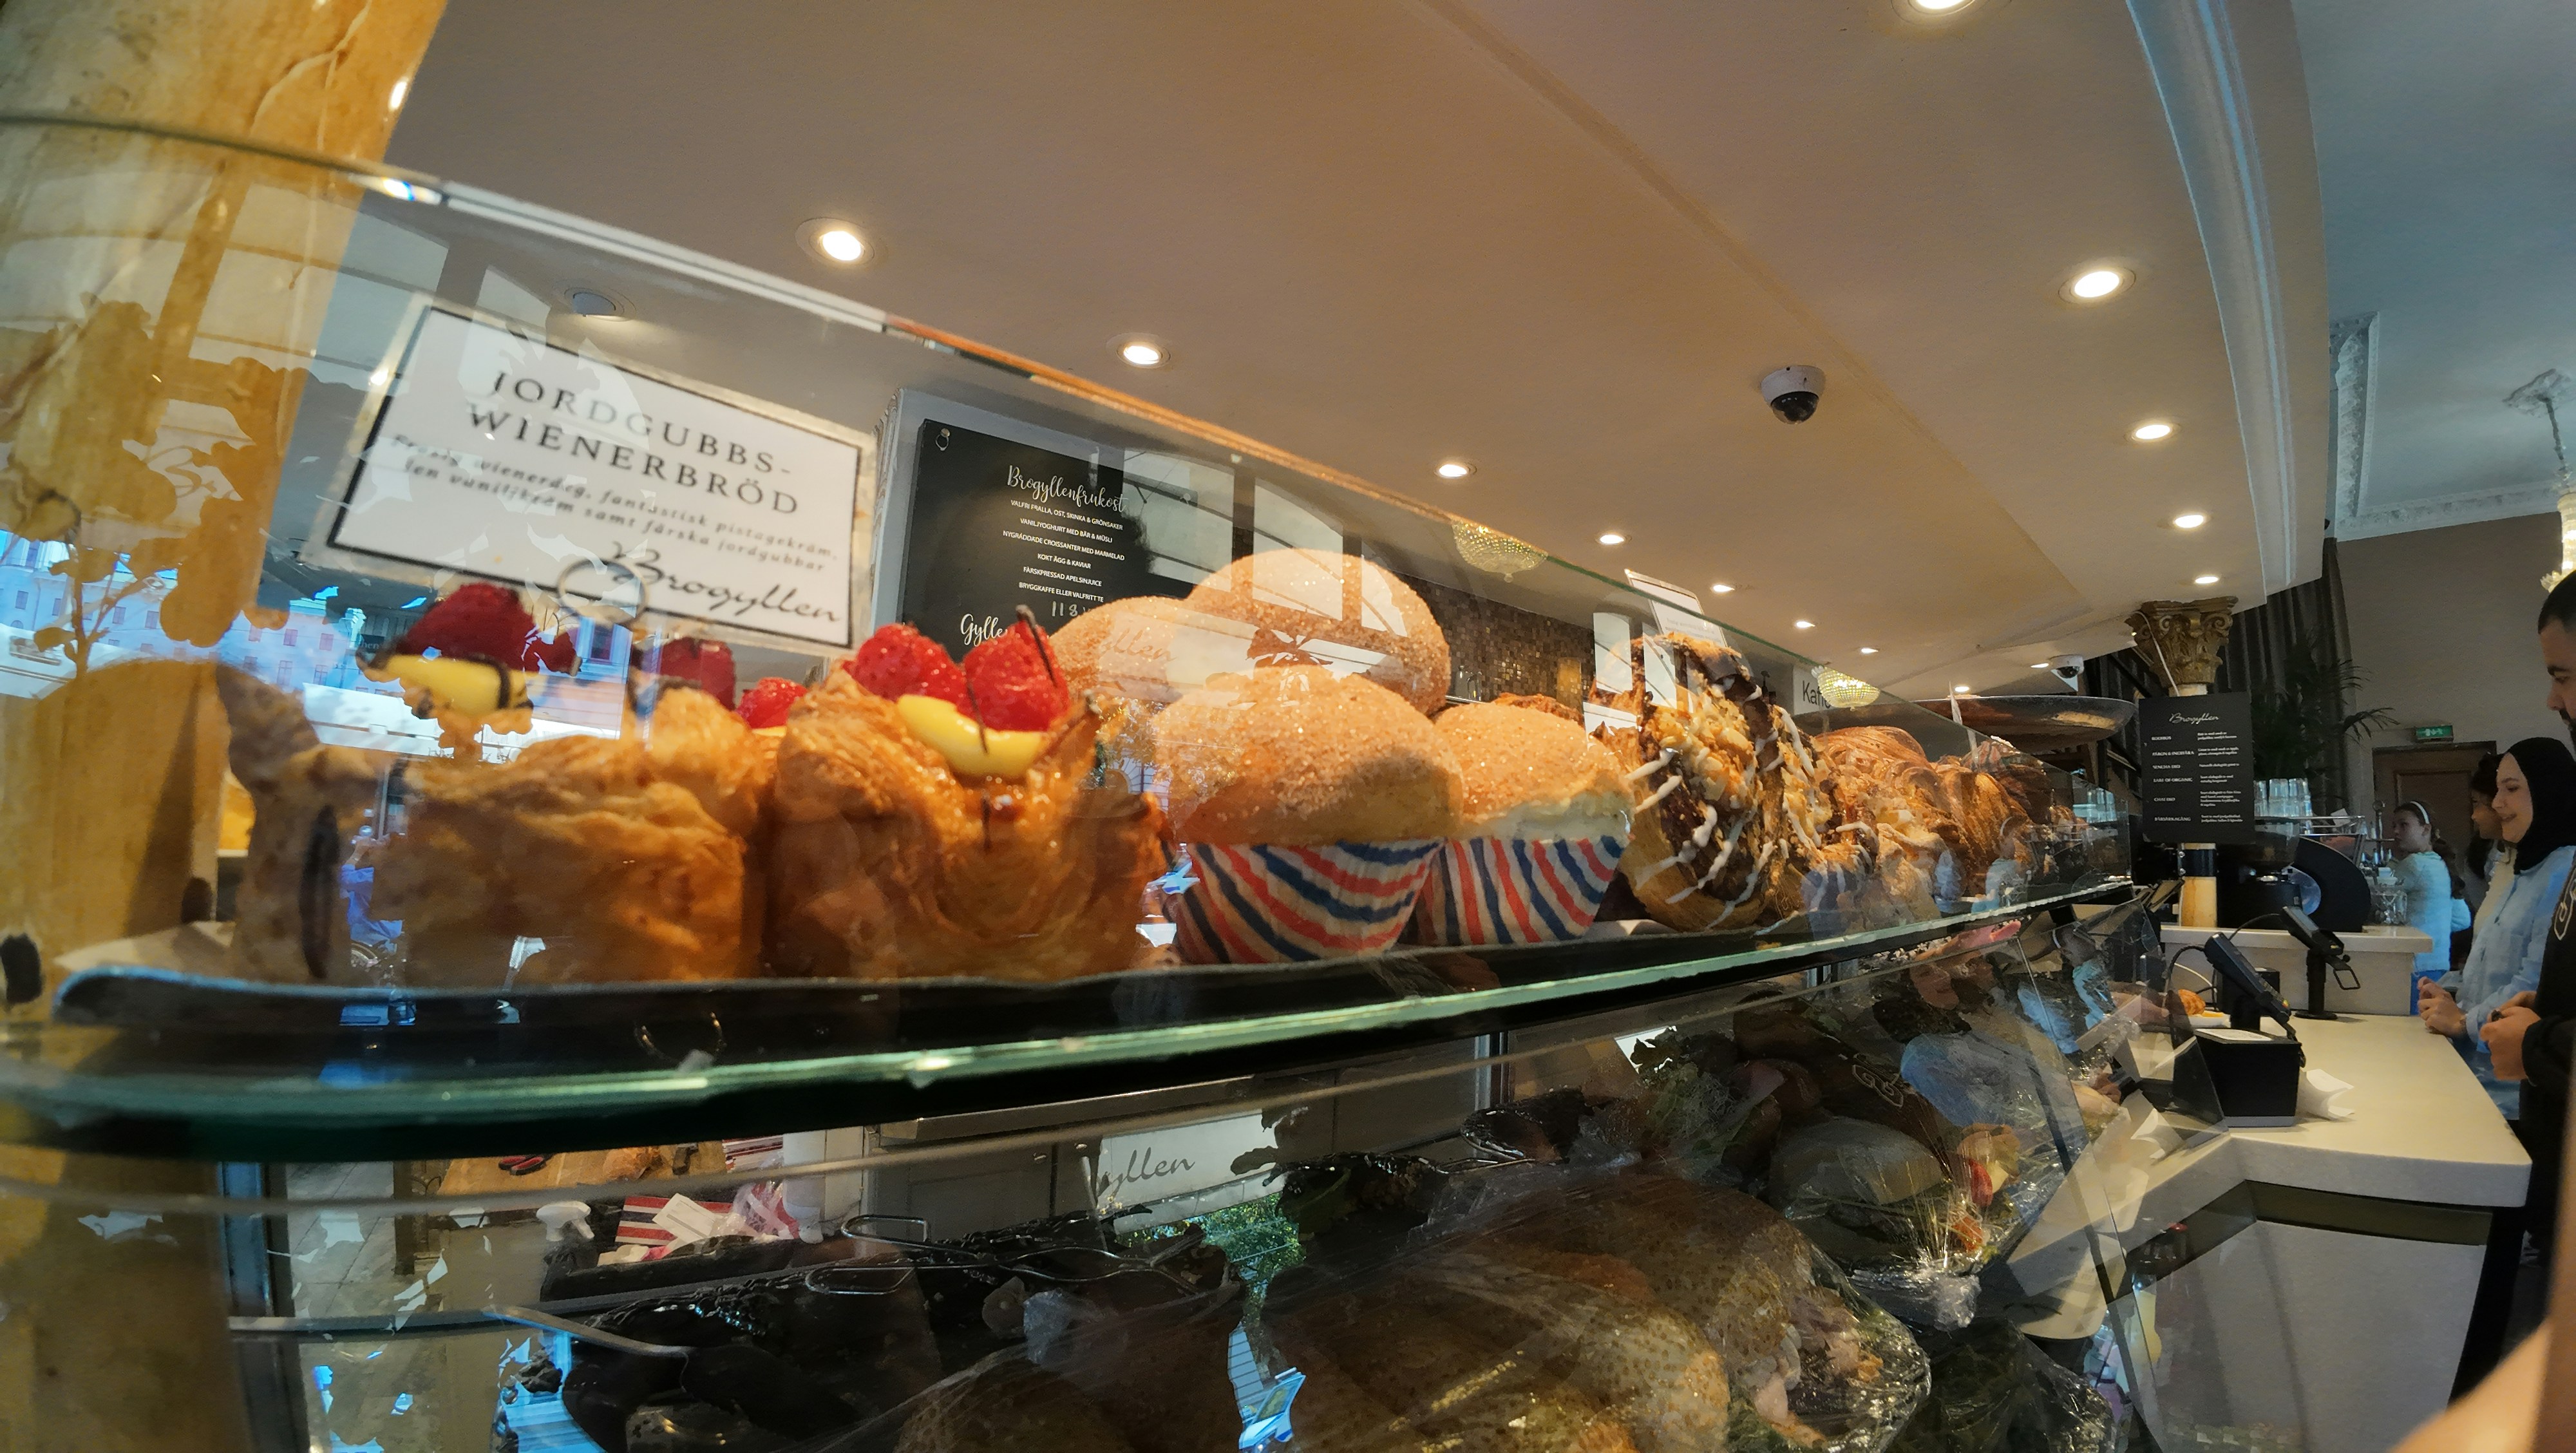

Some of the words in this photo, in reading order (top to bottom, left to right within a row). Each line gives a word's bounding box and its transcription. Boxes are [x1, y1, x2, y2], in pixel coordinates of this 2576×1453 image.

[493, 372, 791, 475] JORDGUBBS-
[468, 403, 797, 513] WIENERBRÖD
[1007, 465, 1129, 513] Brogyllenfrukost
[1011, 500, 1030, 509] VALFRI
[1030, 504, 1053, 515] FRALLA,
[1066, 512, 1086, 522] SKINKA
[1092, 518, 1124, 531] GRÖNSAKER
[1020, 518, 1066, 533] VANILJYOGHURT
[1079, 529, 1091, 538] BÄR
[1096, 534, 1113, 543] MÜSLI
[585, 509, 635, 527] samt
[641, 520, 709, 545] färska
[717, 539, 825, 571] jordgubbar
[1003, 530, 1043, 544] NYGRÄDDADE
[1043, 538, 1081, 552] CROISSANTER
[1081, 546, 1094, 555] MED
[1094, 549, 1125, 561] MARMELAD
[1023, 566, 1065, 580] FÄRSKPRESSAD
[1065, 574, 1103, 587] APELSINJUICE
[1037, 553, 1053, 562] KOKT
[1072, 559, 1092, 569] KAVIAR
[612, 540, 840, 622] Brogyllen
[1019, 582, 1056, 594] BRYGGKAFFE
[1056, 588, 1072, 597] ELLER
[1072, 591, 1099, 602] VALFRITT
[1052, 601, 1078, 617] 118
[960, 613, 1008, 647] Gylle
[2169, 712, 2219, 724] Brogyllen
